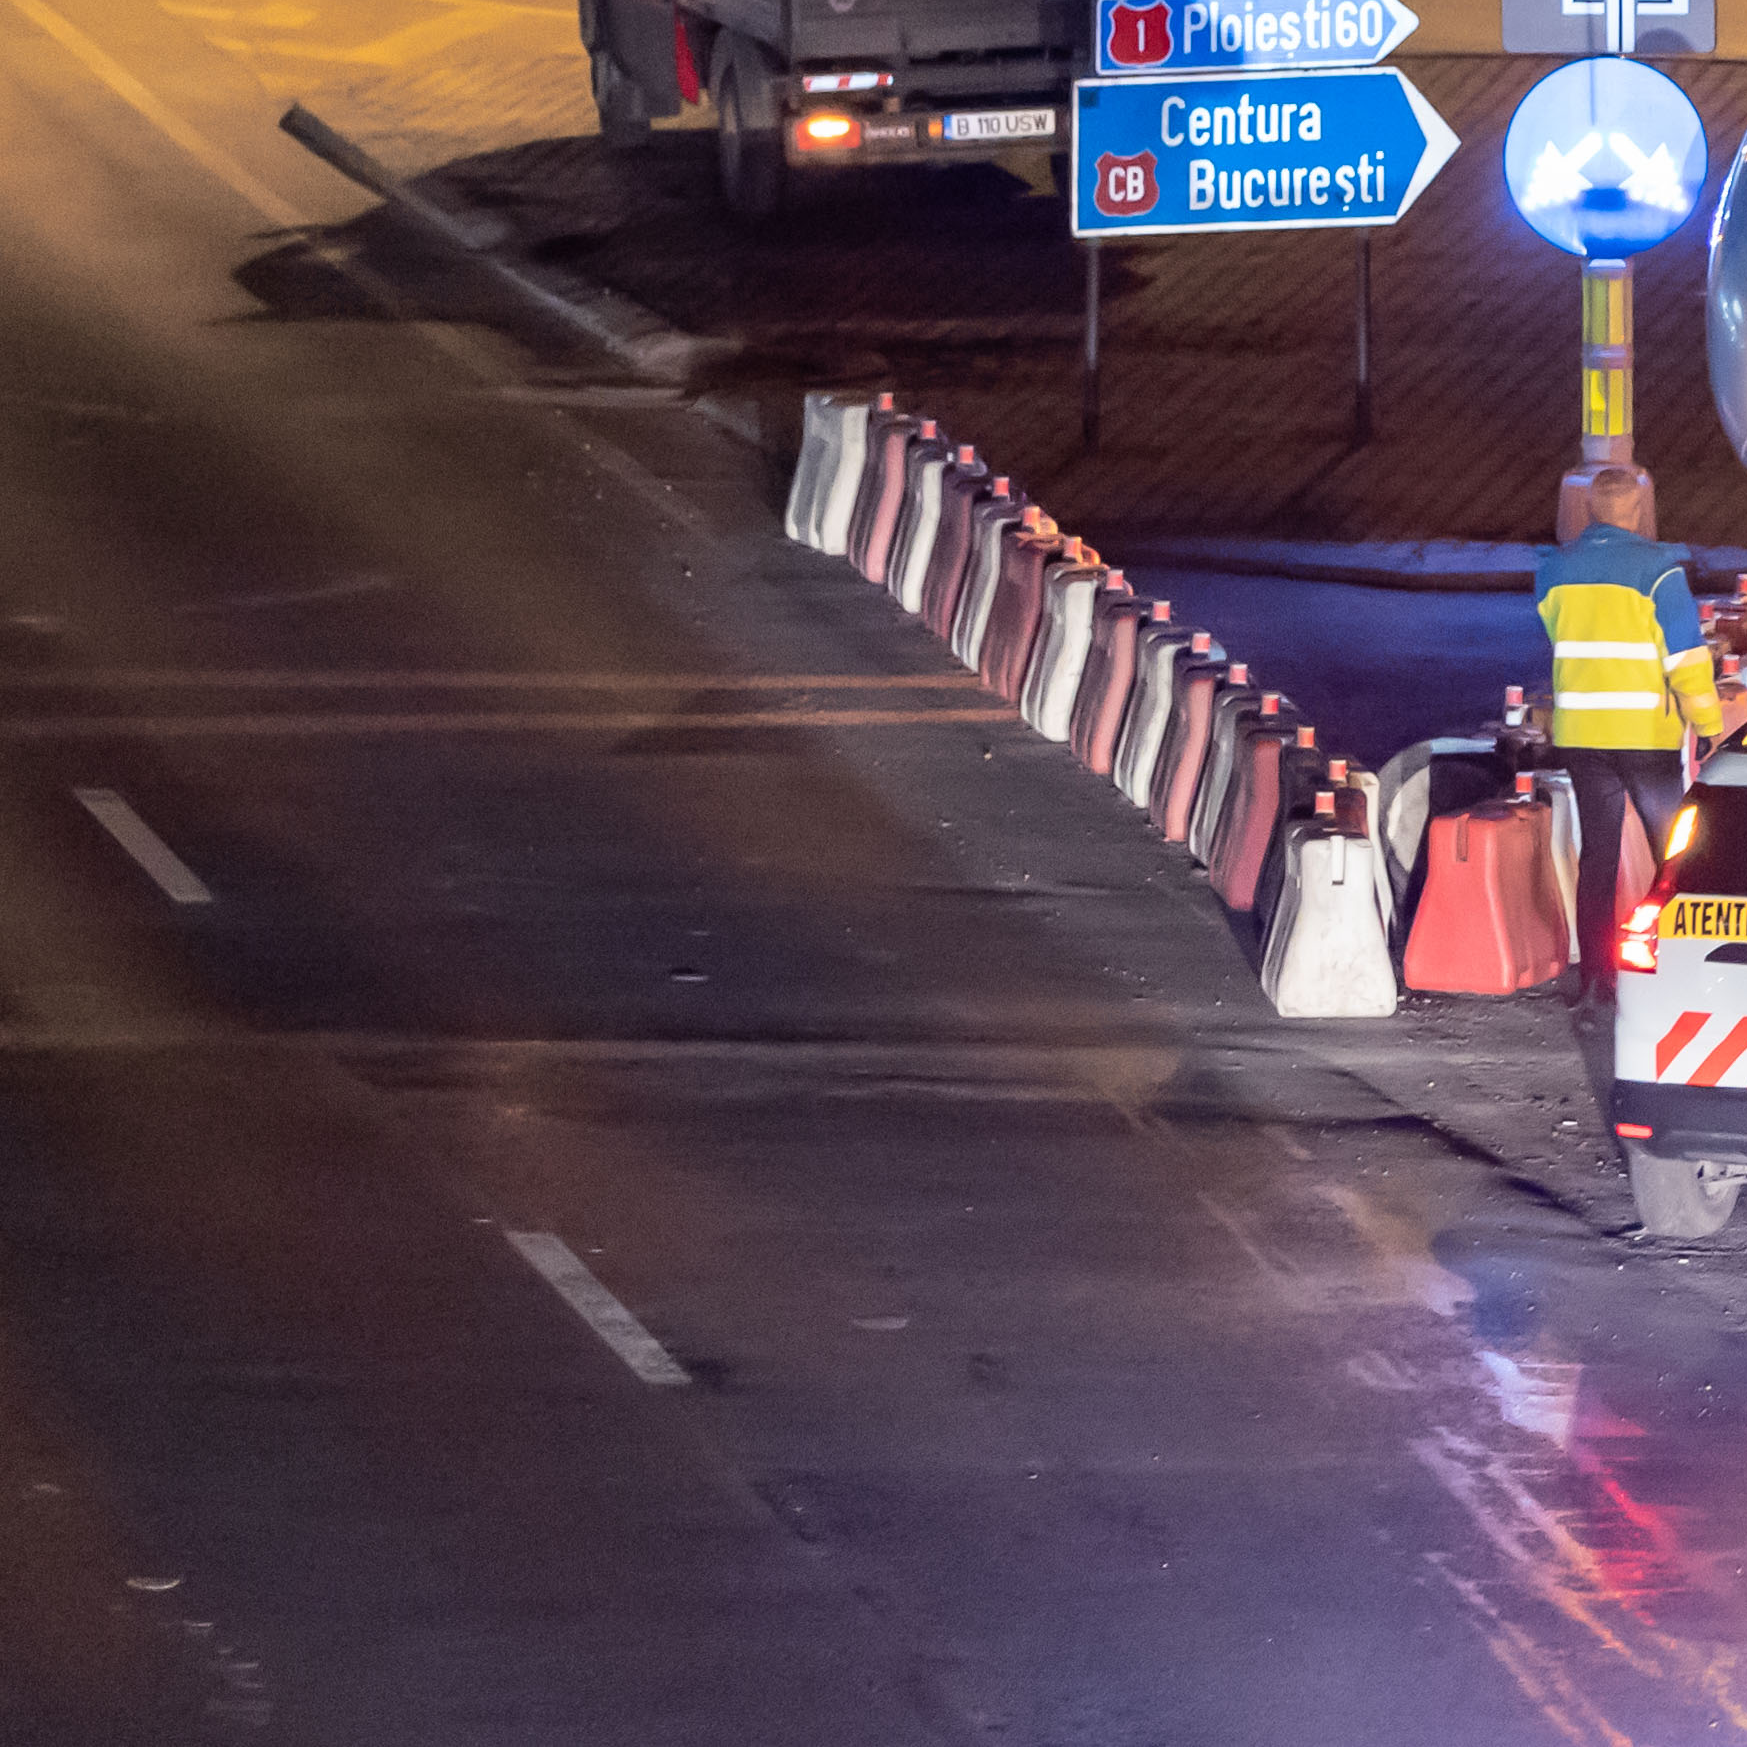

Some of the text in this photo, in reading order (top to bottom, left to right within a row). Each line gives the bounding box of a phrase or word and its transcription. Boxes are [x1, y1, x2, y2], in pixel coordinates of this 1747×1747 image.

[1134, 8, 1147, 52] 1
[1182, 0, 1332, 62] Ploiești
[956, 114, 1051, 136] B 110 USW
[1159, 94, 1324, 147] Centura
[1107, 166, 1145, 202] CB
[1188, 151, 1386, 213] București
